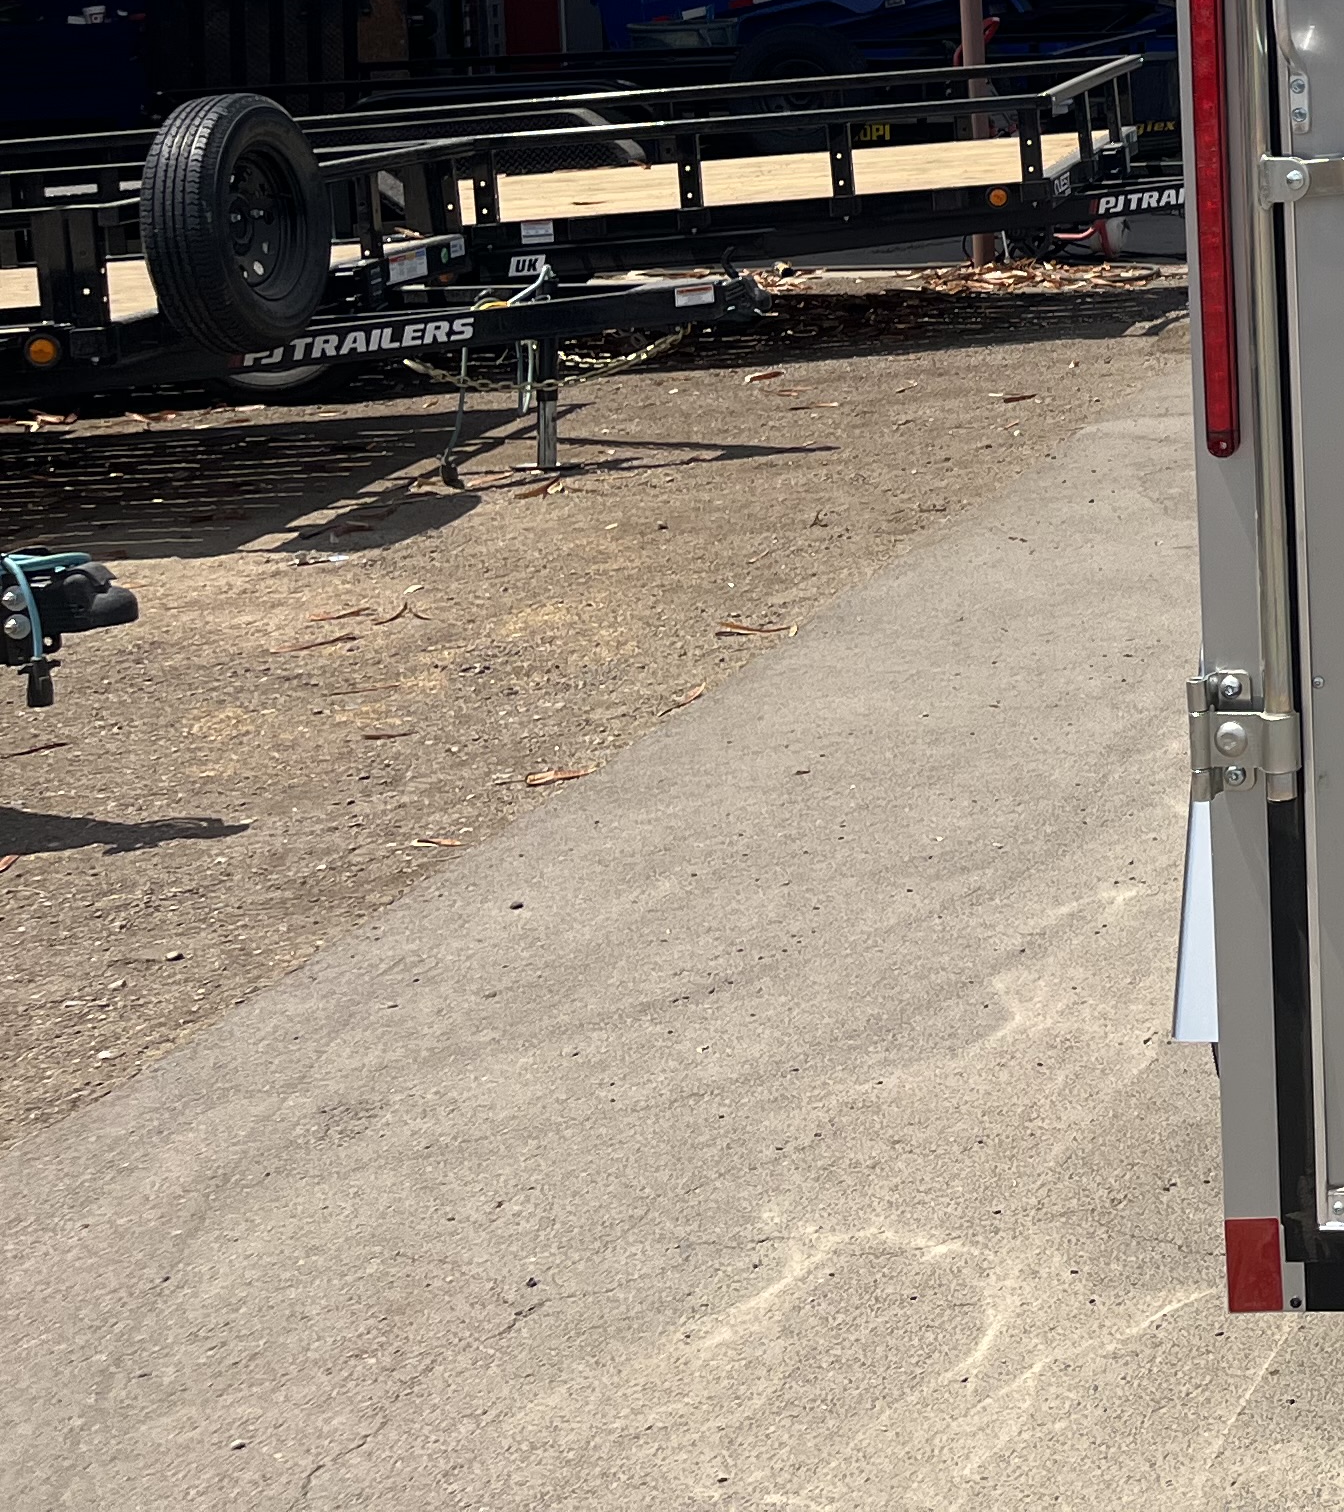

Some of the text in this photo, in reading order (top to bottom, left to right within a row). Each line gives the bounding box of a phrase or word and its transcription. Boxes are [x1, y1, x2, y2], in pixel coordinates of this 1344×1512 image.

[1098, 188, 1185, 215] PJ TRAI
[515, 257, 539, 273] UK
[289, 317, 475, 361] TRAILERS
